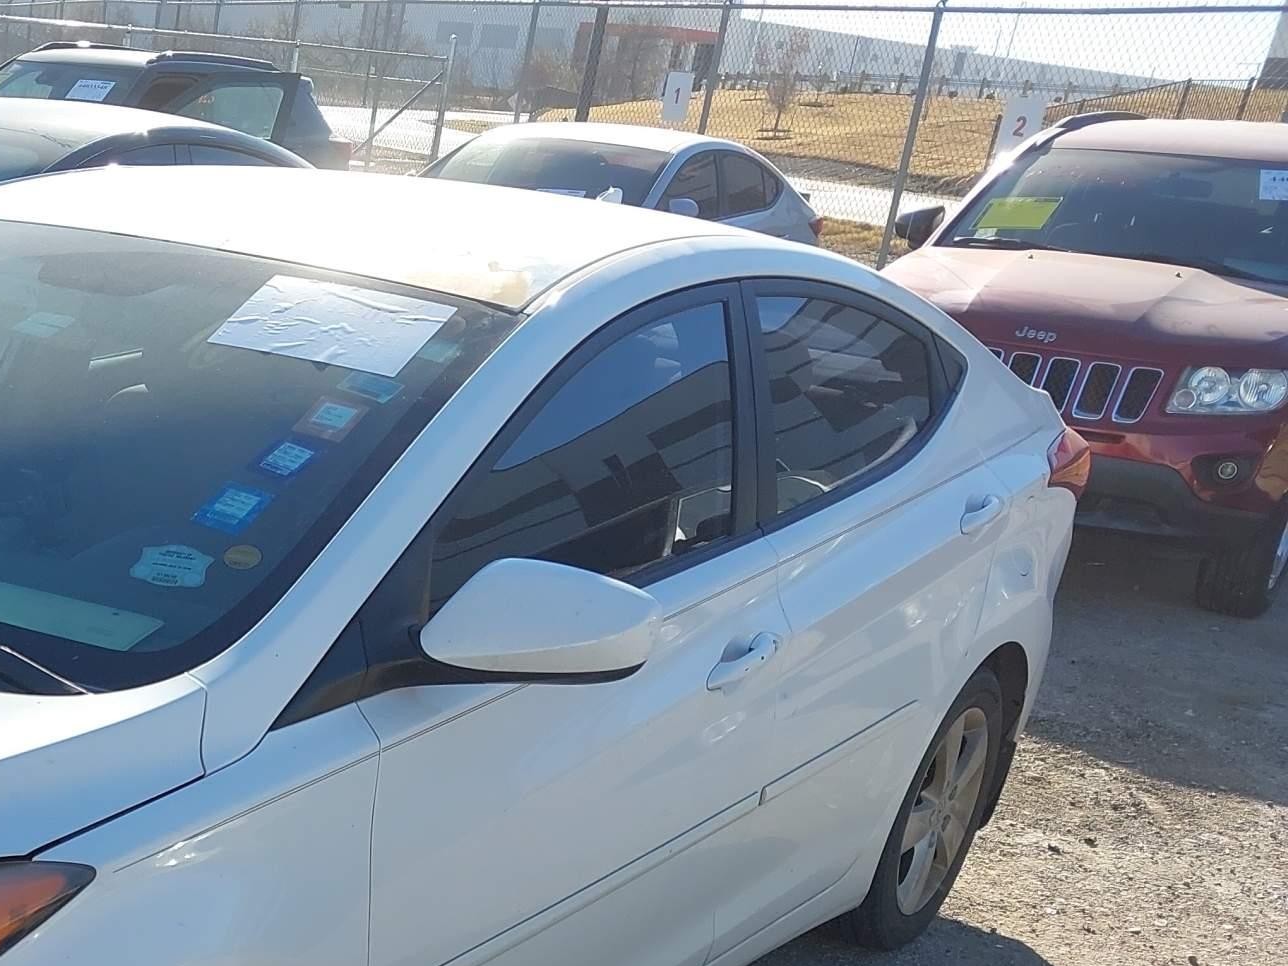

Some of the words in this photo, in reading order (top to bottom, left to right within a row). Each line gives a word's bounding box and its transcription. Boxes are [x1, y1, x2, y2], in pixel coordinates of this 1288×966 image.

[674, 87, 681, 105] 1
[1012, 115, 1028, 137] 2
[1015, 325, 1057, 343] Jeep
